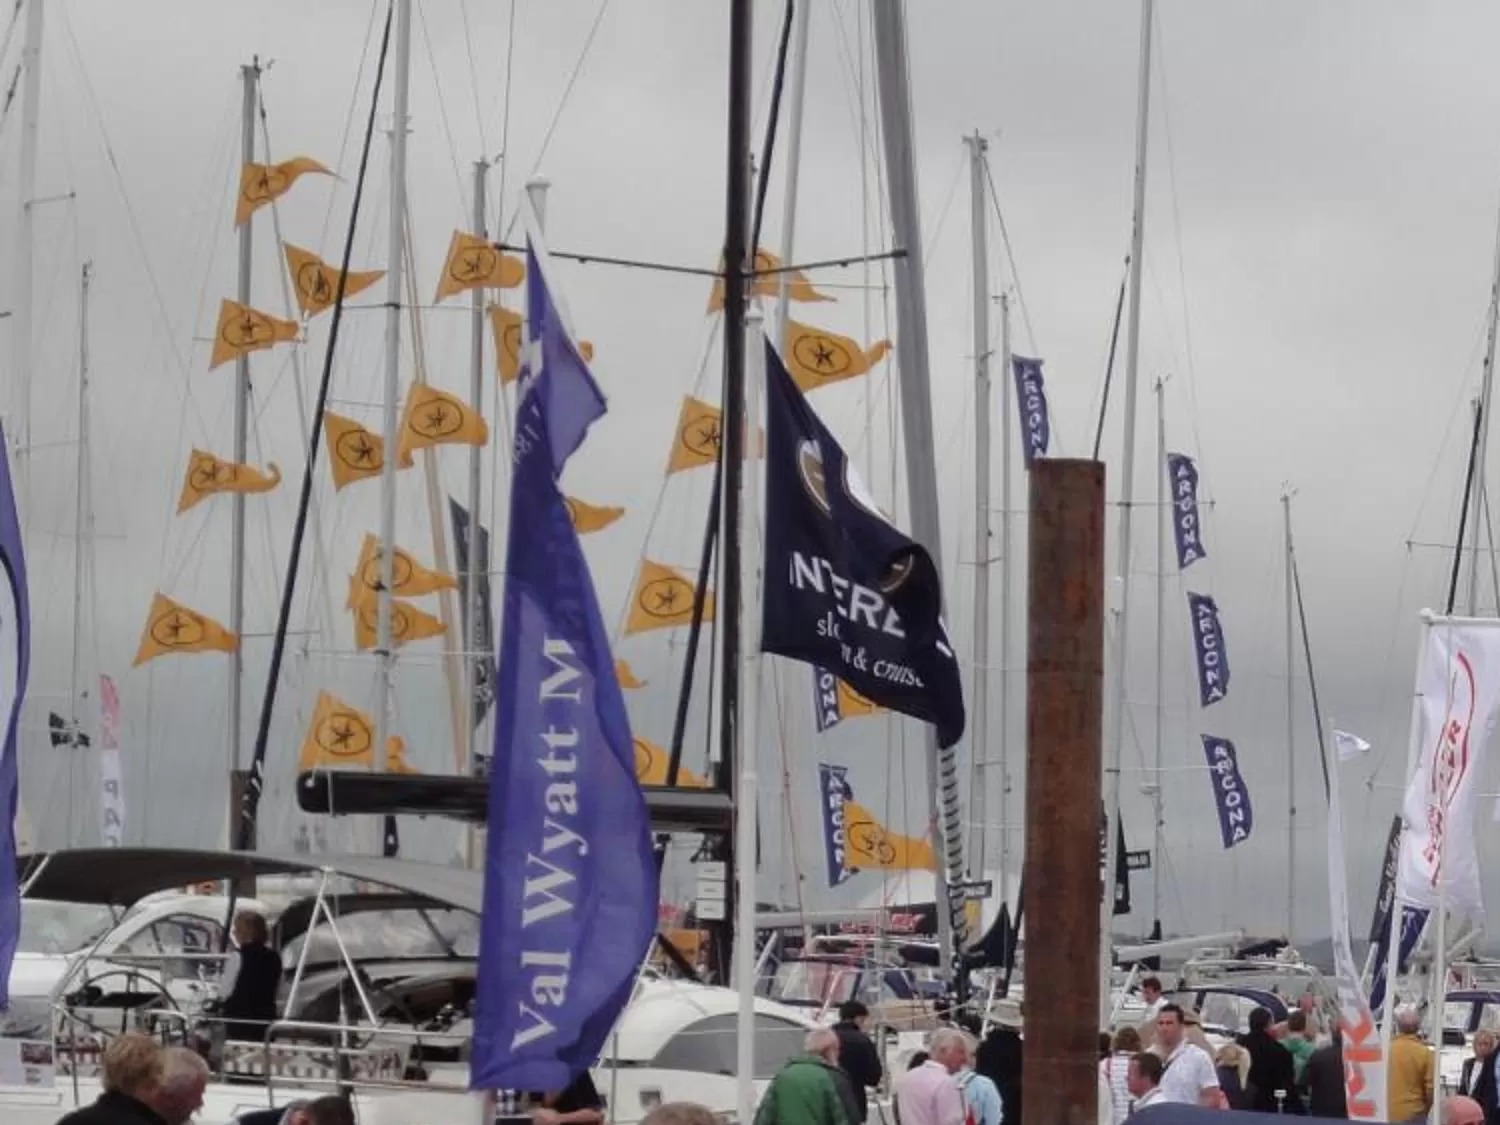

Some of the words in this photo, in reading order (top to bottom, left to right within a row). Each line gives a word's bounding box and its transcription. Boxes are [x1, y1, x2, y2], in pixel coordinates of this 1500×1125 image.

[1177, 465, 1198, 562] ARCONA
[820, 672, 838, 726] ONA
[1197, 604, 1223, 700] ARCONA
[521, 724, 589, 928] Wyatt
[511, 948, 572, 1052] Val
